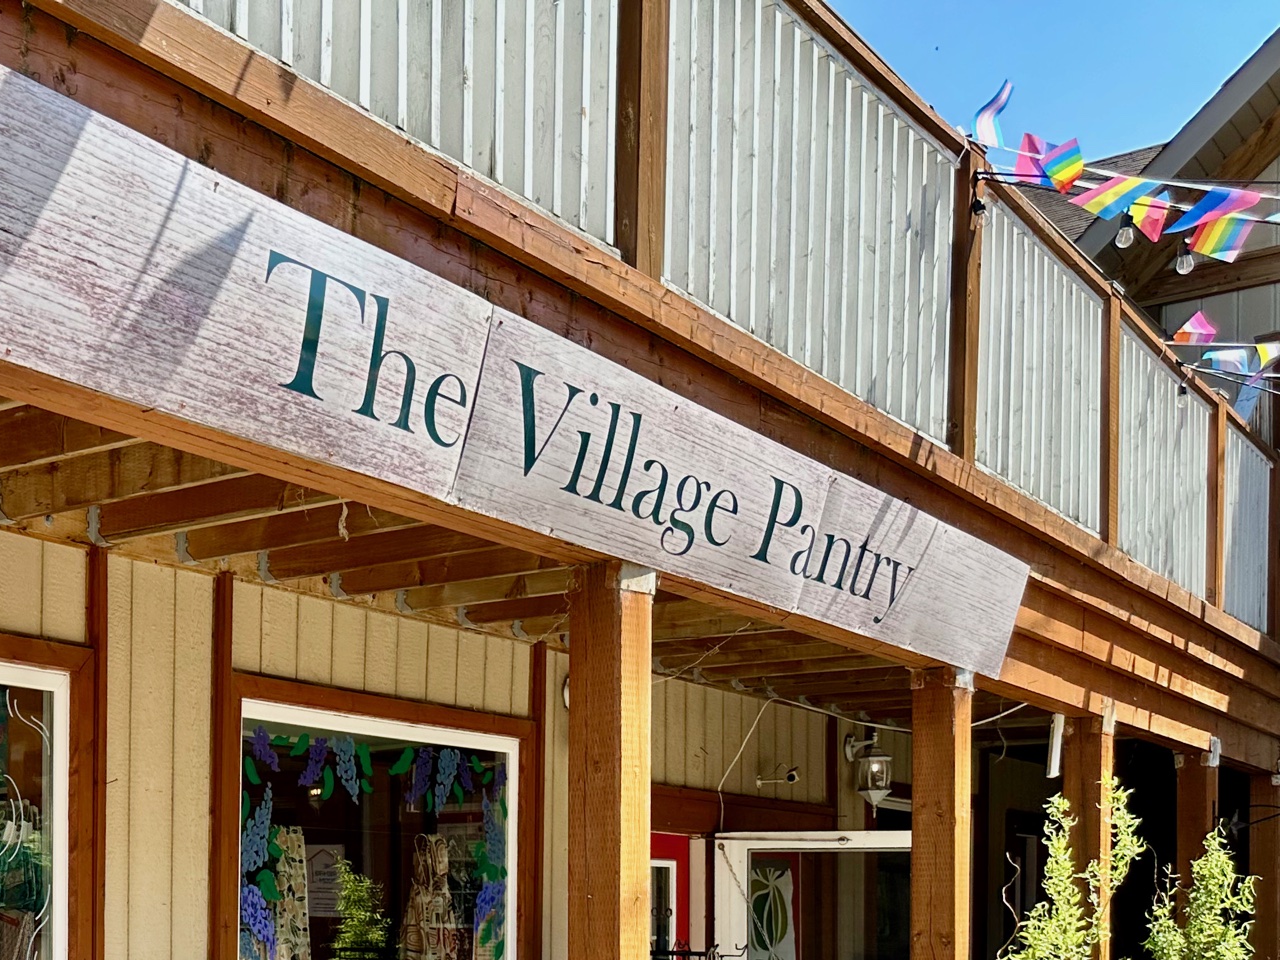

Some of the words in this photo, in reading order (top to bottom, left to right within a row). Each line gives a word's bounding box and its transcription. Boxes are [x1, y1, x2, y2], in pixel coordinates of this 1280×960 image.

[264, 249, 467, 448] The
[511, 359, 739, 556] Village
[749, 475, 915, 624] Pantry
